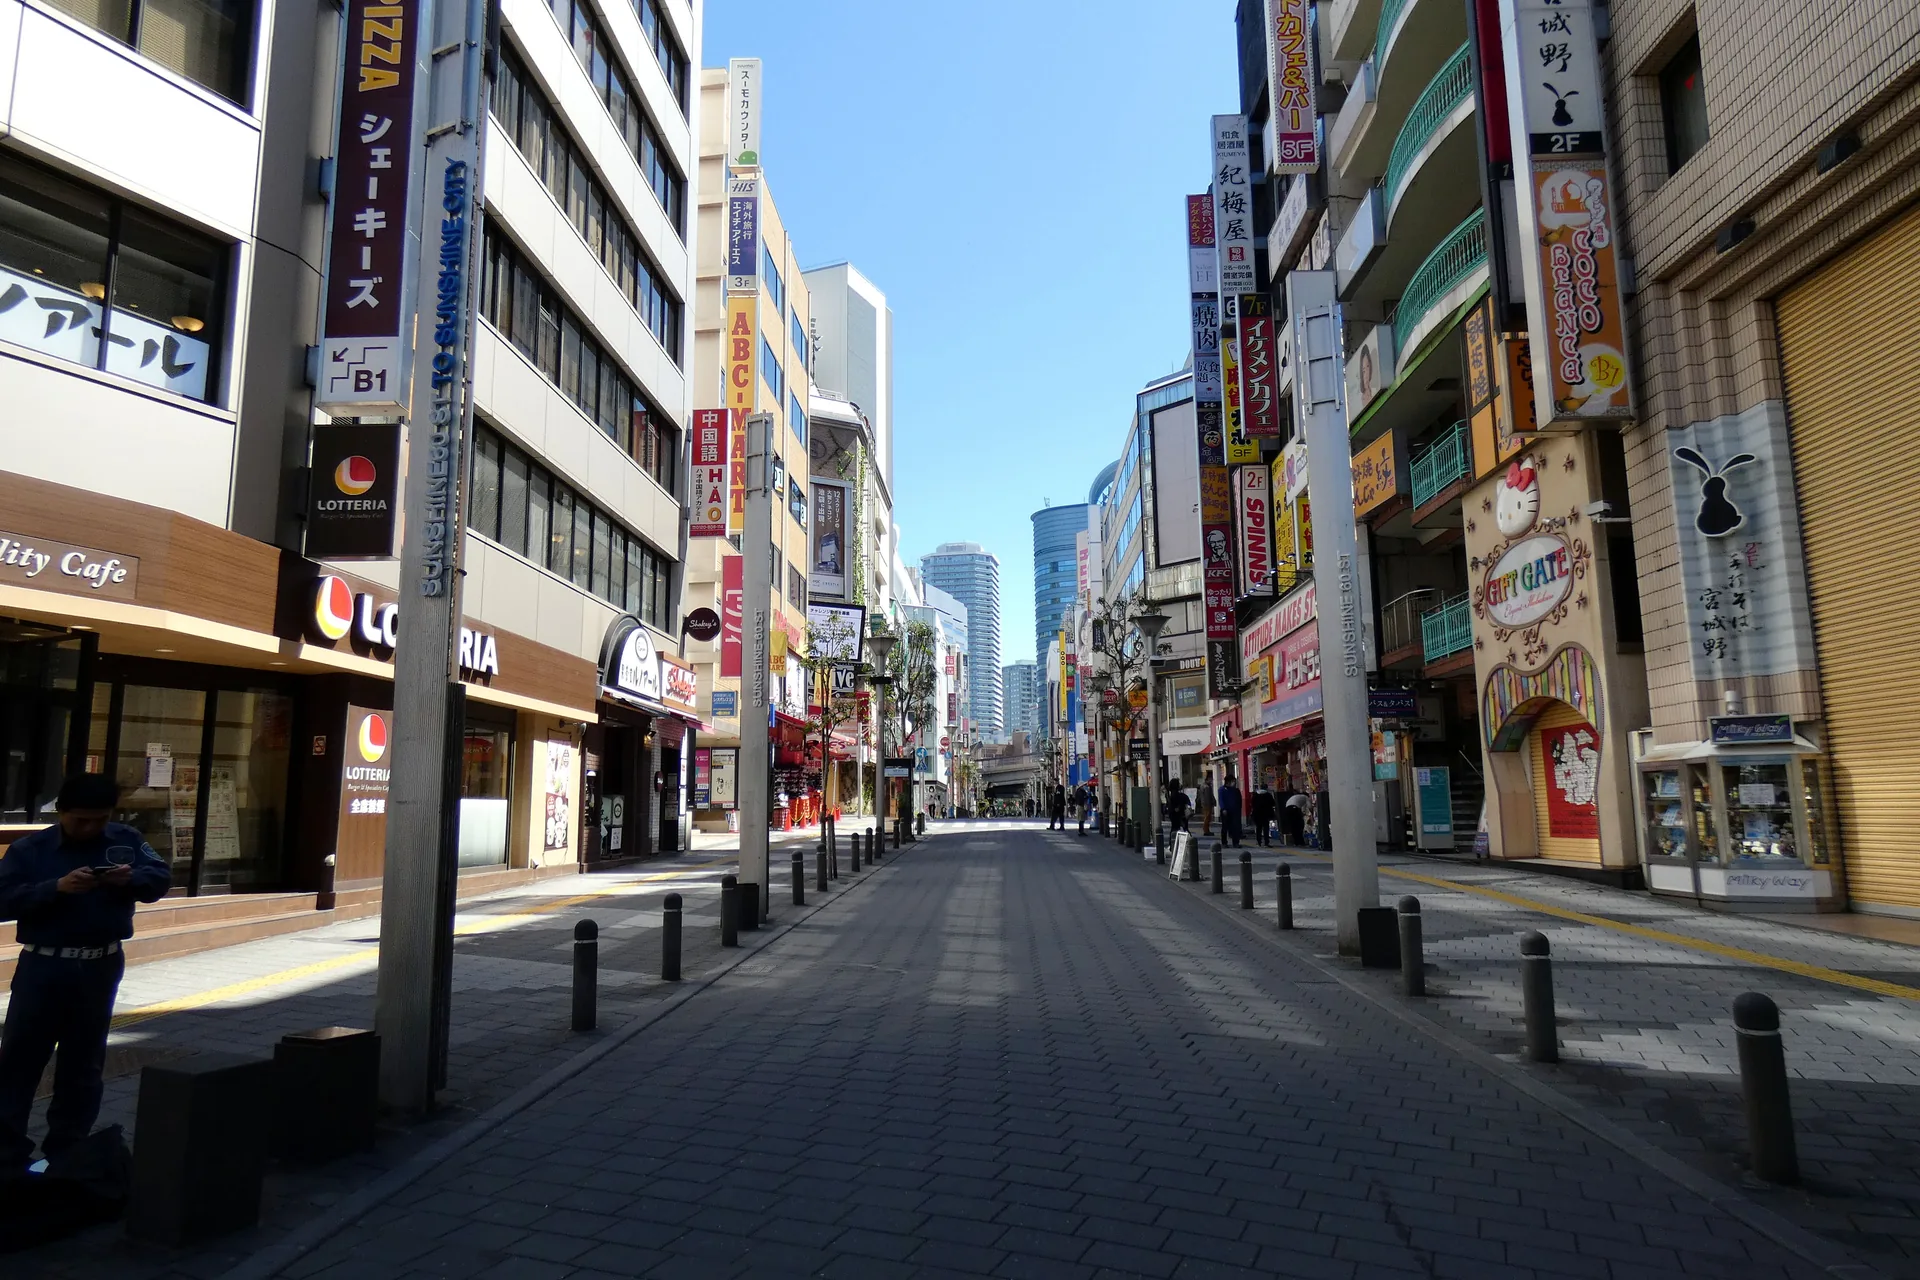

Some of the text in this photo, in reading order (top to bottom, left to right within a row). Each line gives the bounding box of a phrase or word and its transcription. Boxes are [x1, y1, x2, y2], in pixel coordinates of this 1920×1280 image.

[359, 0, 403, 92] IZZA
[1537, 0, 1573, 74] 城野
[740, 70, 750, 150] スーモカウンター
[1217, 140, 1245, 149] 居酒屋
[1221, 131, 1240, 140] 和食
[1282, 140, 1314, 160] 5F
[1550, 134, 1580, 153] 2F
[732, 182, 755, 193] HIS
[1219, 164, 1248, 241] 紀梅屋
[345, 113, 394, 310] シェーキーズ
[743, 201, 753, 240] 海外旅行
[431, 156, 467, 390] TO SUNSHINE CITY
[734, 277, 750, 287] 3F
[1572, 229, 1601, 331] COCO
[1243, 295, 1267, 315] 7F
[1194, 305, 1218, 351] 焼肉
[353, 369, 388, 393] B1
[1246, 319, 1272, 425] イケメンカフェ
[1590, 355, 1621, 387] B1
[701, 410, 719, 463] 中国語
[1233, 448, 1253, 458] 3F
[1247, 471, 1263, 488] 2F
[317, 500, 388, 511] LOTTERIA
[421, 396, 452, 598] SUNSHINE 60 ST
[1246, 497, 1268, 586] SPINNS
[60, 551, 128, 588] Cafe
[1207, 569, 1230, 578] KFC
[1485, 546, 1569, 607] GIFT GATE
[1206, 588, 1232, 596] ゆったり
[1207, 596, 1233, 608] 客席
[689, 619, 717, 630] Shakey's
[1243, 618, 1273, 659] ATTITUDE
[1274, 597, 1303, 642] MAKES
[1337, 550, 1358, 677] SUNSHINE 60 ST
[1699, 588, 1728, 659] 宮城野
[363, 593, 499, 676] LORIA
[752, 608, 765, 708] SUNSHINE 60 ST
[1175, 739, 1203, 747] SoftBank
[1215, 720, 1229, 747] KFC
[1717, 723, 1787, 736] Milky Way
[1726, 874, 1811, 891] Milky Way
